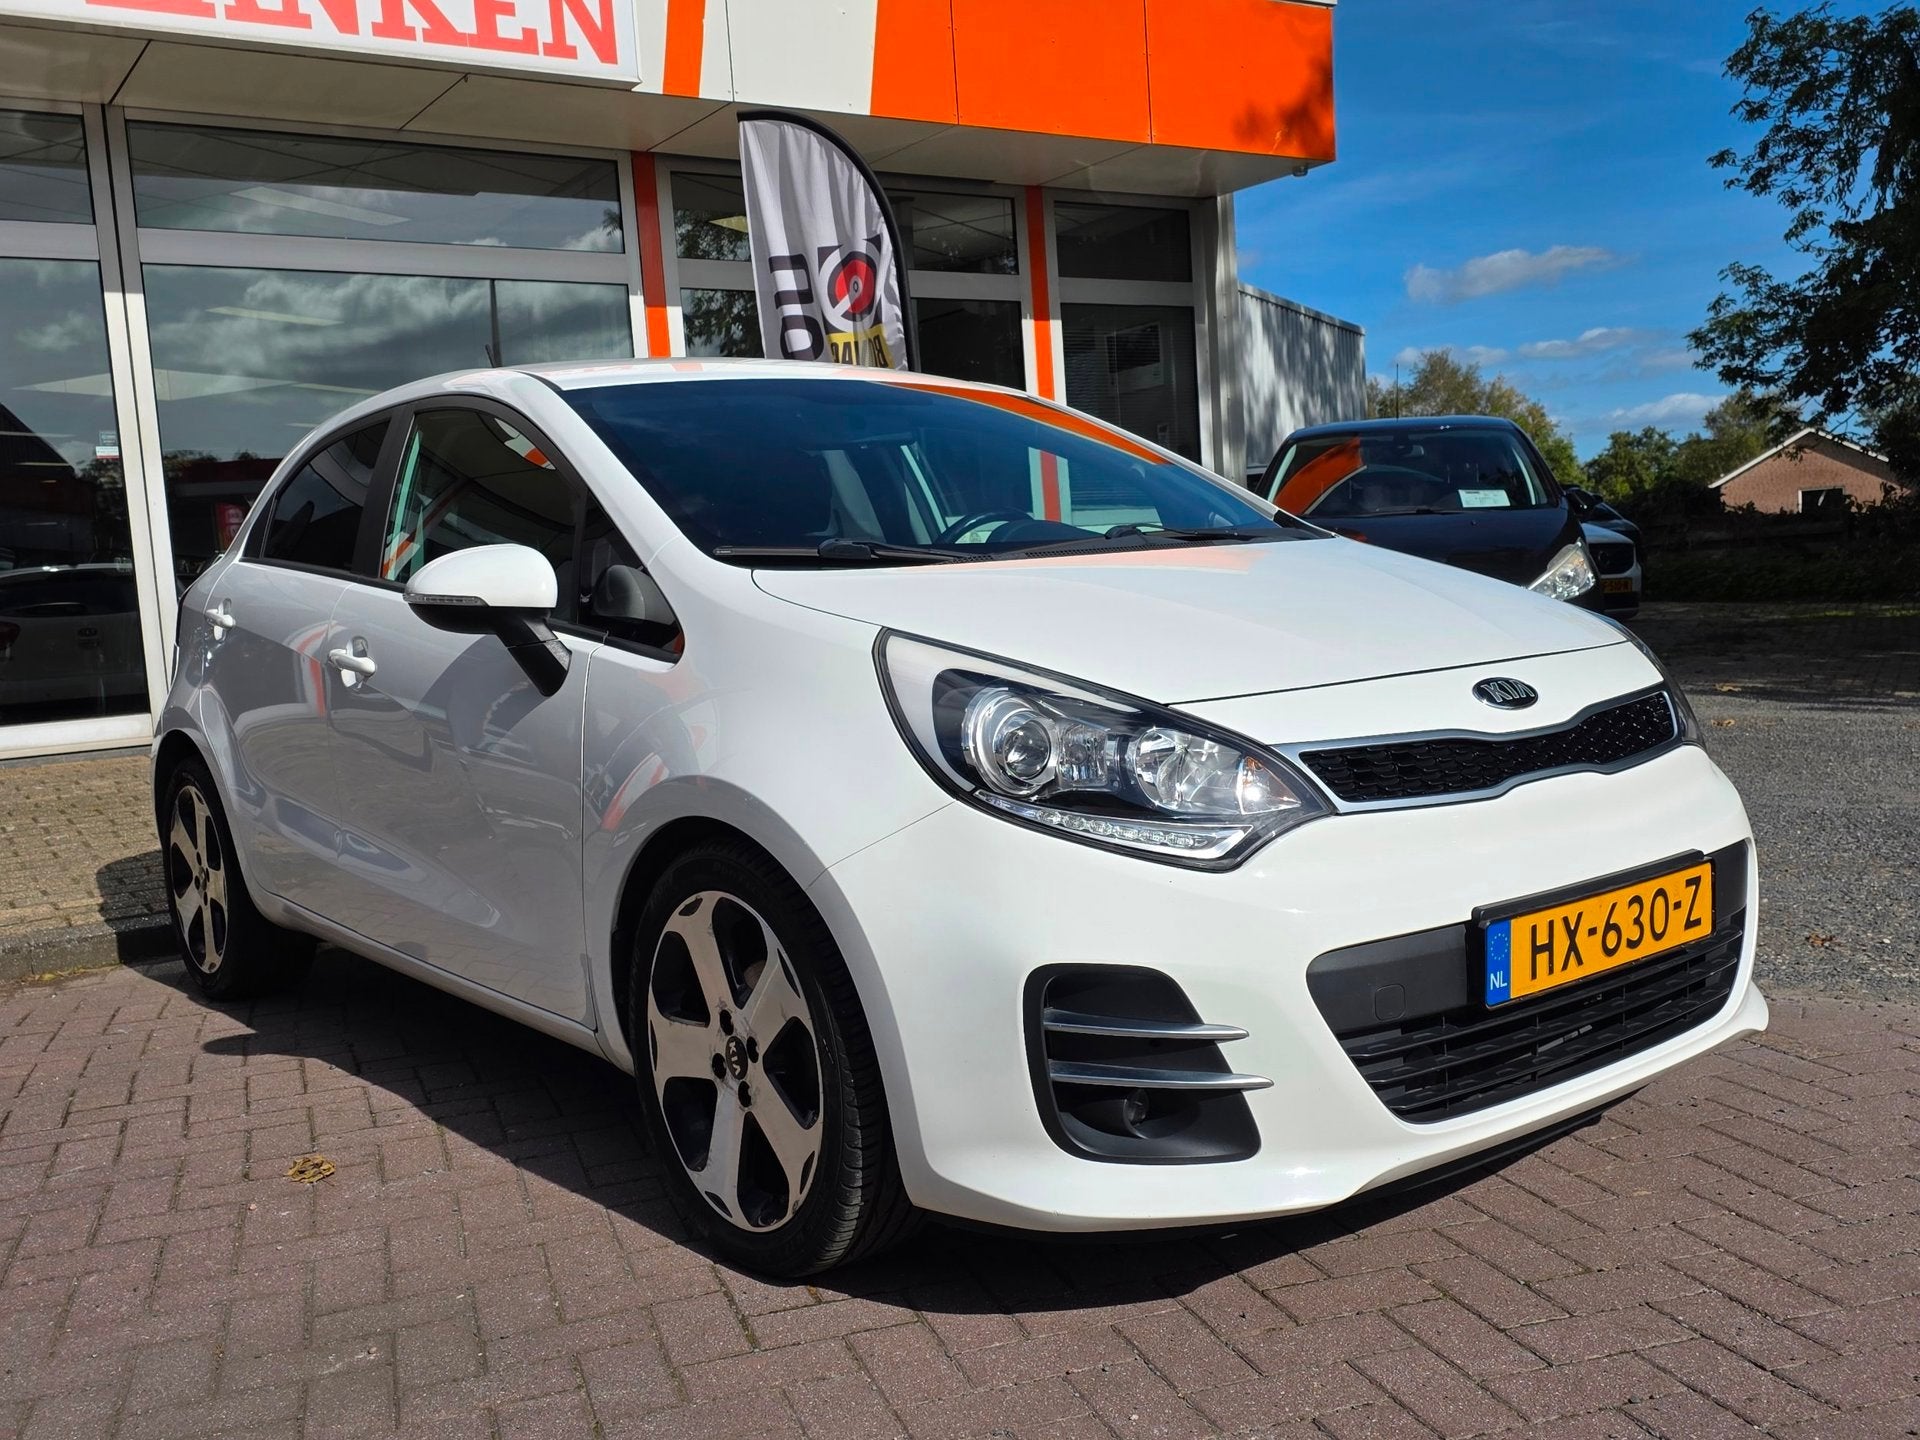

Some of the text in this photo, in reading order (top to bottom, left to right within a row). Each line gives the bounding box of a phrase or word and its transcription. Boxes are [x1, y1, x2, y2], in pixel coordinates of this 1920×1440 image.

[1480, 680, 1535, 702] KIA
[1531, 875, 1702, 981] HX-630-Z
[1490, 971, 1508, 991] NL
[729, 1041, 741, 1076] KIA
